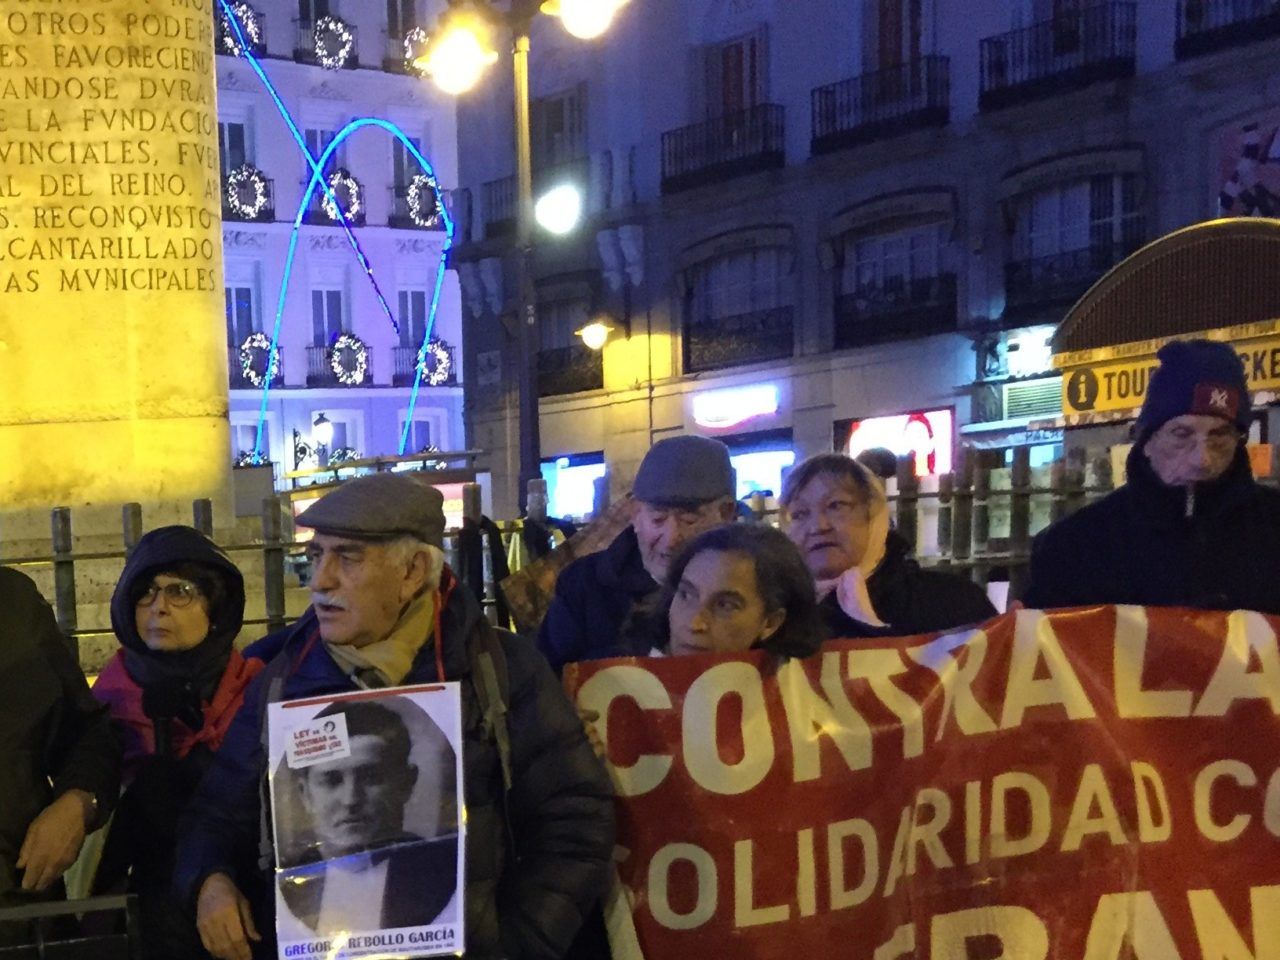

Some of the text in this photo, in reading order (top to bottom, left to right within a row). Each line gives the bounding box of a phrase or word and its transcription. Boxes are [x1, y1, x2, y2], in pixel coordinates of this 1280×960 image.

[7, 12, 106, 35] OTROS
[26, 108, 62, 132] LA
[39, 174, 93, 197] DEL
[110, 174, 192, 197] REINO.
[33, 206, 212, 232] RECONQVISTO
[59, 268, 216, 293] MVNICIPALES
[576, 604, 1280, 797] CONTRA LA
[613, 760, 1173, 930] OLIDARIDAD
[348, 932, 404, 950] REBOLLO
[408, 928, 455, 945] GARCÍA
